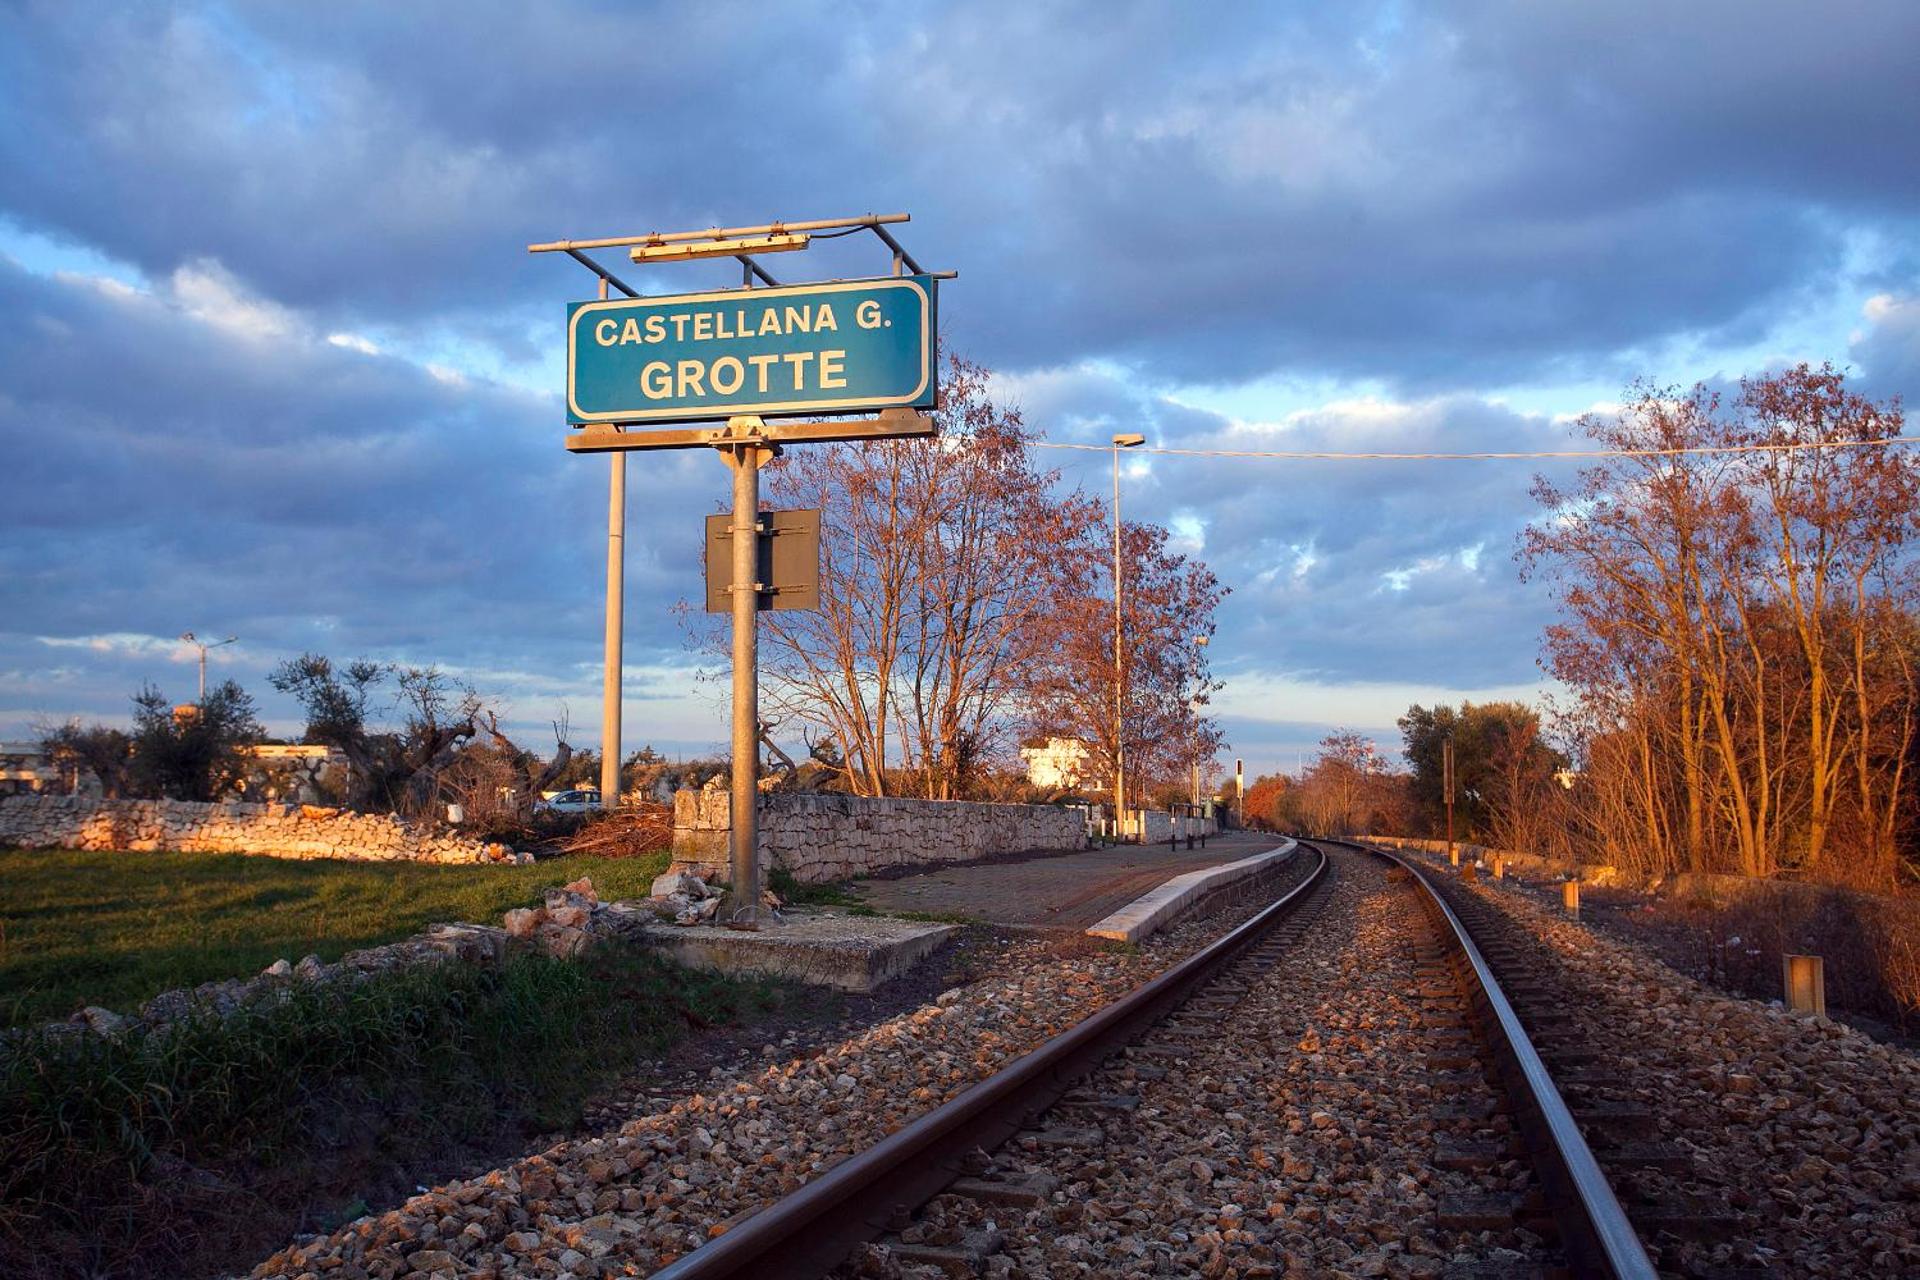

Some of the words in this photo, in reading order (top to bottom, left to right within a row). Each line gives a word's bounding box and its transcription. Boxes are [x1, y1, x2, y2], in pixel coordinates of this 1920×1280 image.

[595, 303, 838, 347] CASTELLANA
[855, 300, 892, 330] G.
[640, 349, 848, 400] GROTTE
